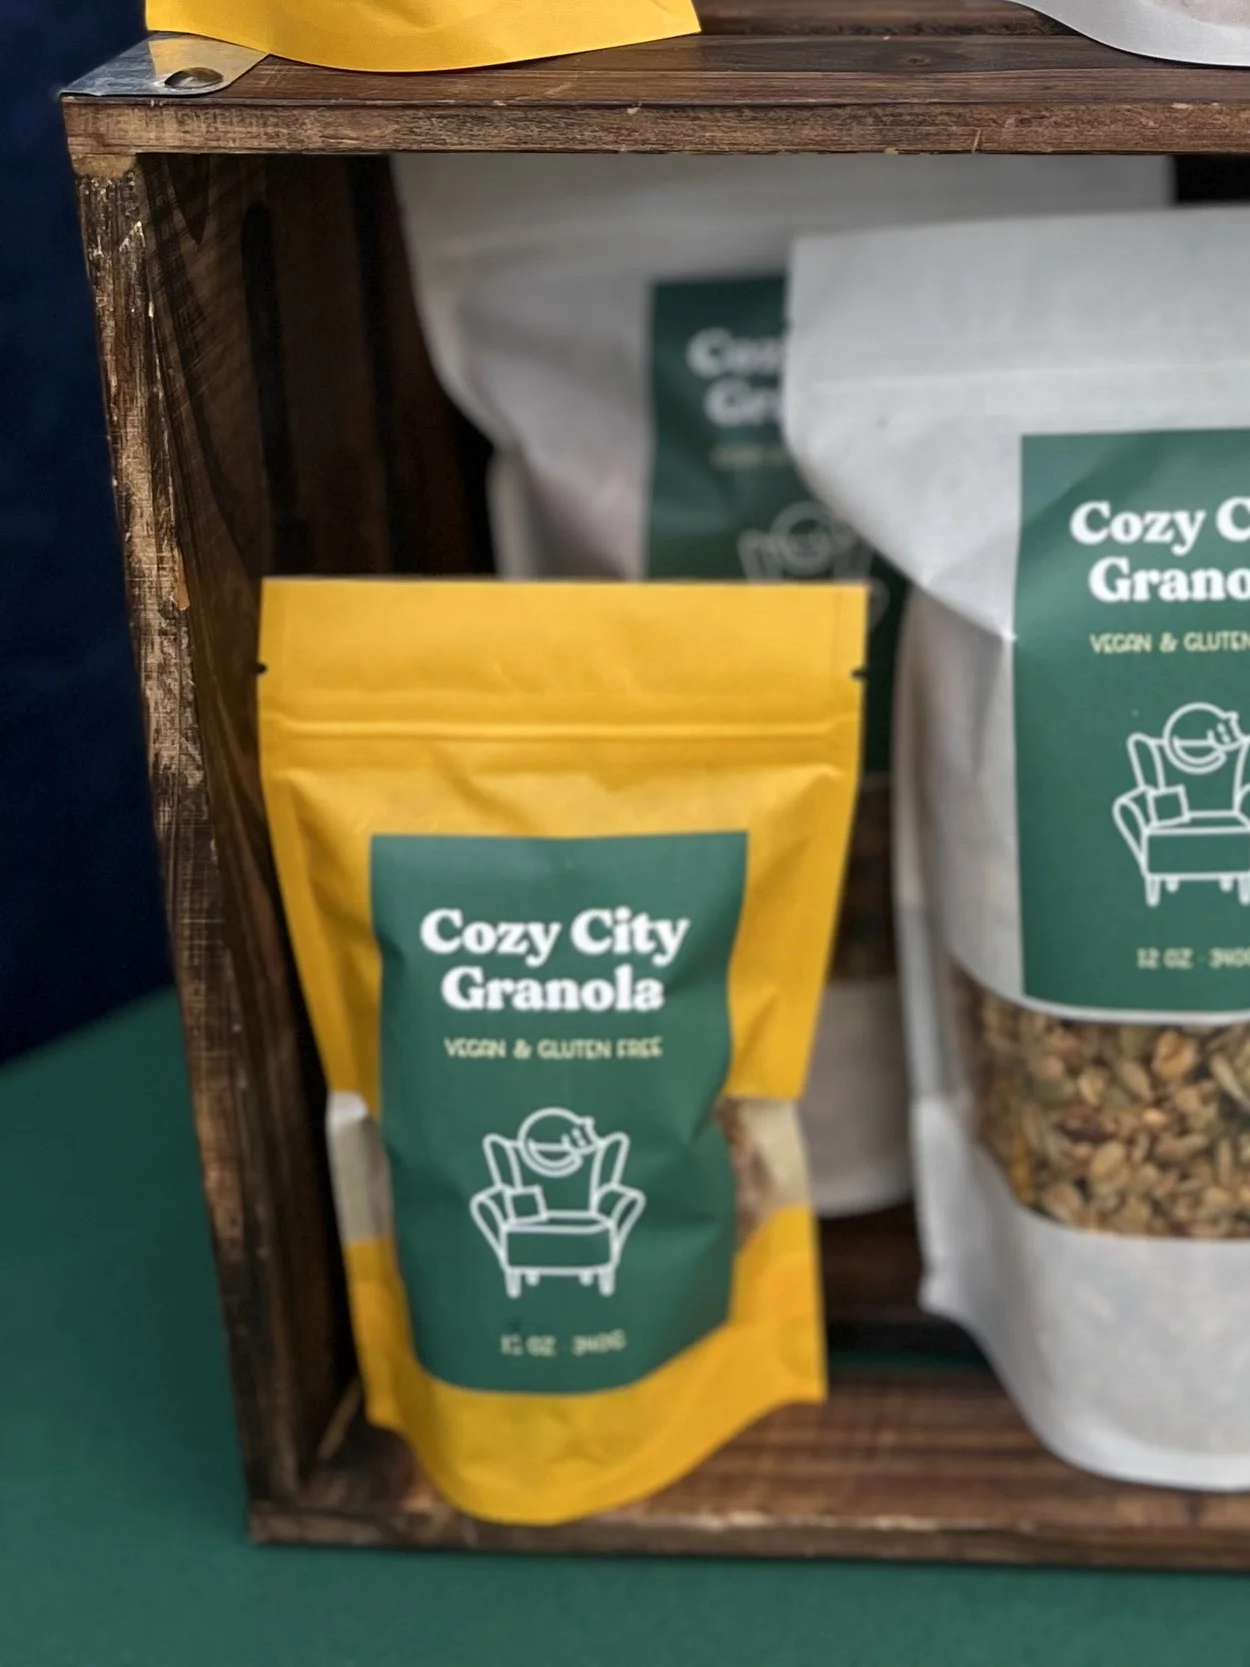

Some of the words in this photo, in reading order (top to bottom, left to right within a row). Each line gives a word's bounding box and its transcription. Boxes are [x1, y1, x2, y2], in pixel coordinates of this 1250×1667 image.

[1070, 501, 1206, 555] Cozy
[1090, 634, 1152, 654] VEGAN
[1159, 634, 1178, 654] &
[420, 908, 561, 967] Cozy
[570, 905, 691, 966] City
[441, 965, 665, 1012] Granola
[444, 1038, 506, 1060] VEGAN
[513, 1038, 533, 1060] &
[537, 1037, 611, 1060] GLUTEN
[617, 1035, 664, 1059] FREE
